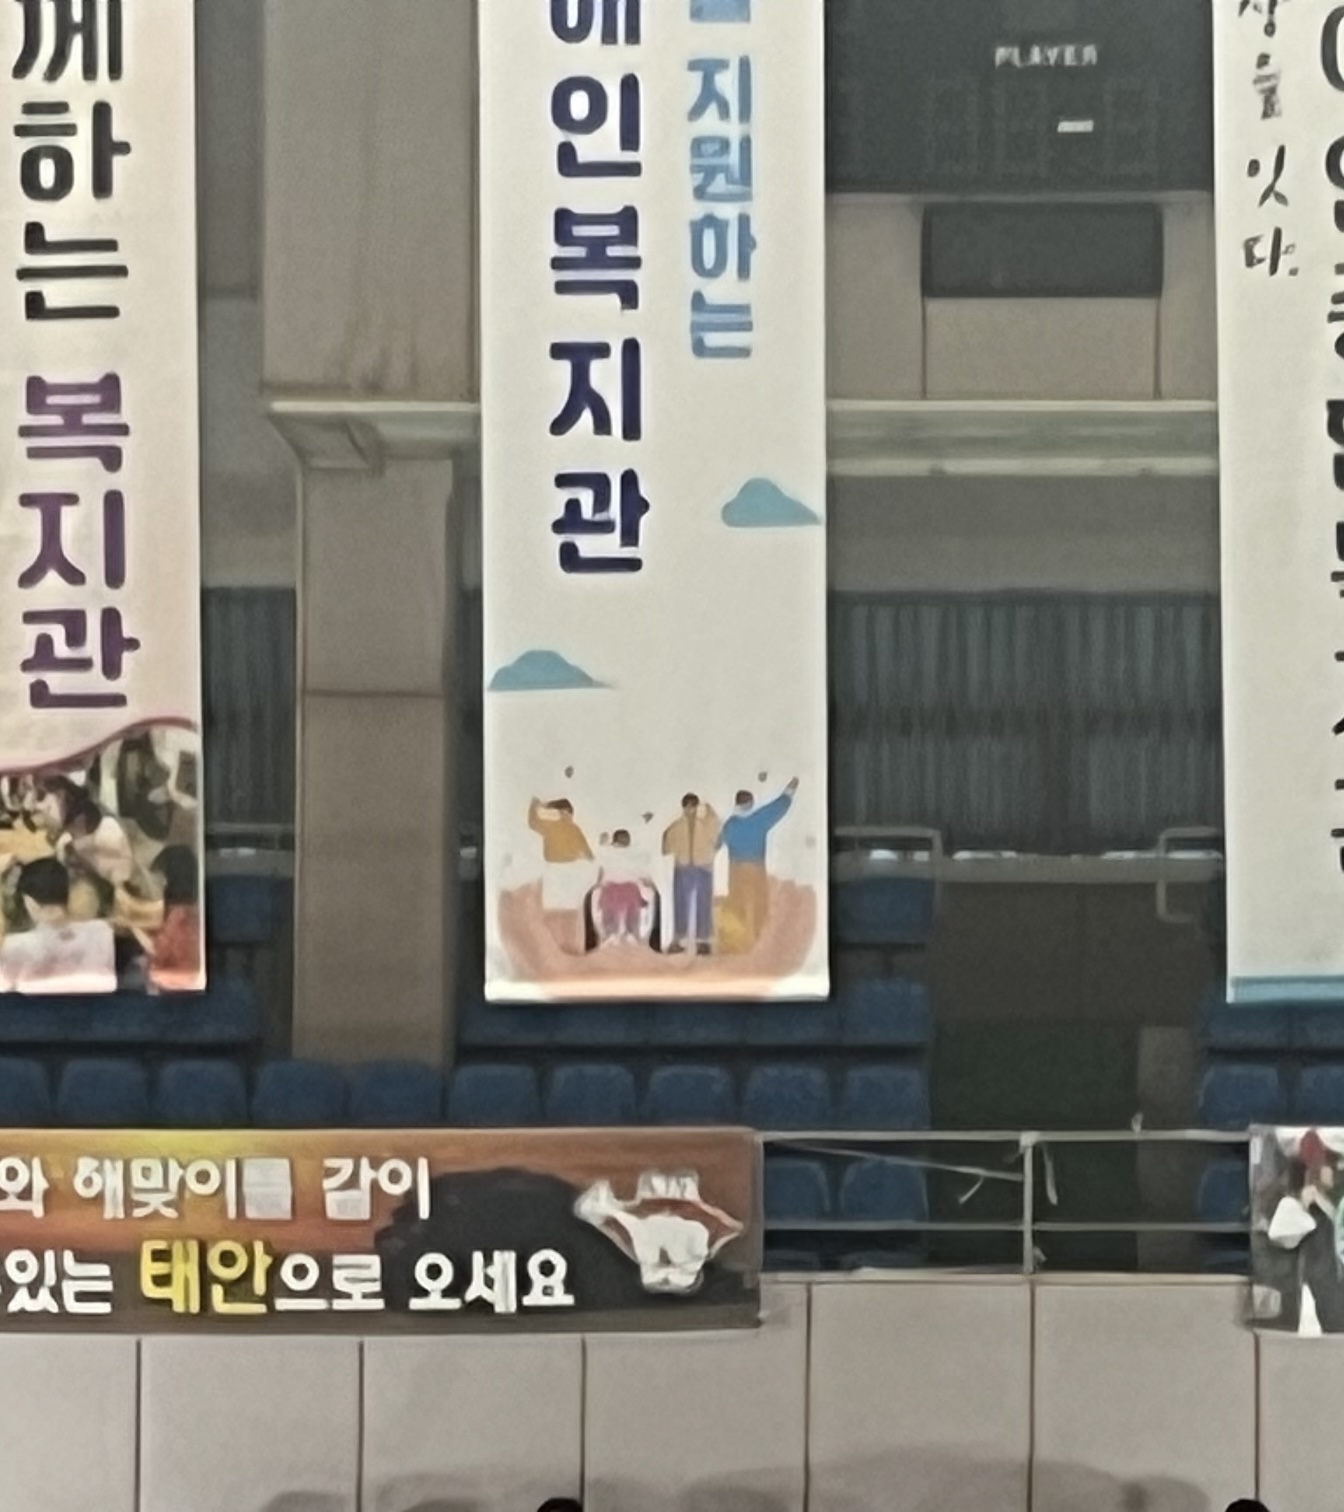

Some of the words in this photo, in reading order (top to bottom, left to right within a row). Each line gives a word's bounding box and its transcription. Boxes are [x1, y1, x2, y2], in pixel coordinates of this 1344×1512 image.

[687, 54, 757, 360] 지원하는
[17, 371, 141, 709] 복지관
[73, 1156, 292, 1220] 해맞이를
[323, 1156, 429, 1220] 같이
[140, 1239, 385, 1314] 태안으로
[409, 1249, 575, 1313] 오세요
